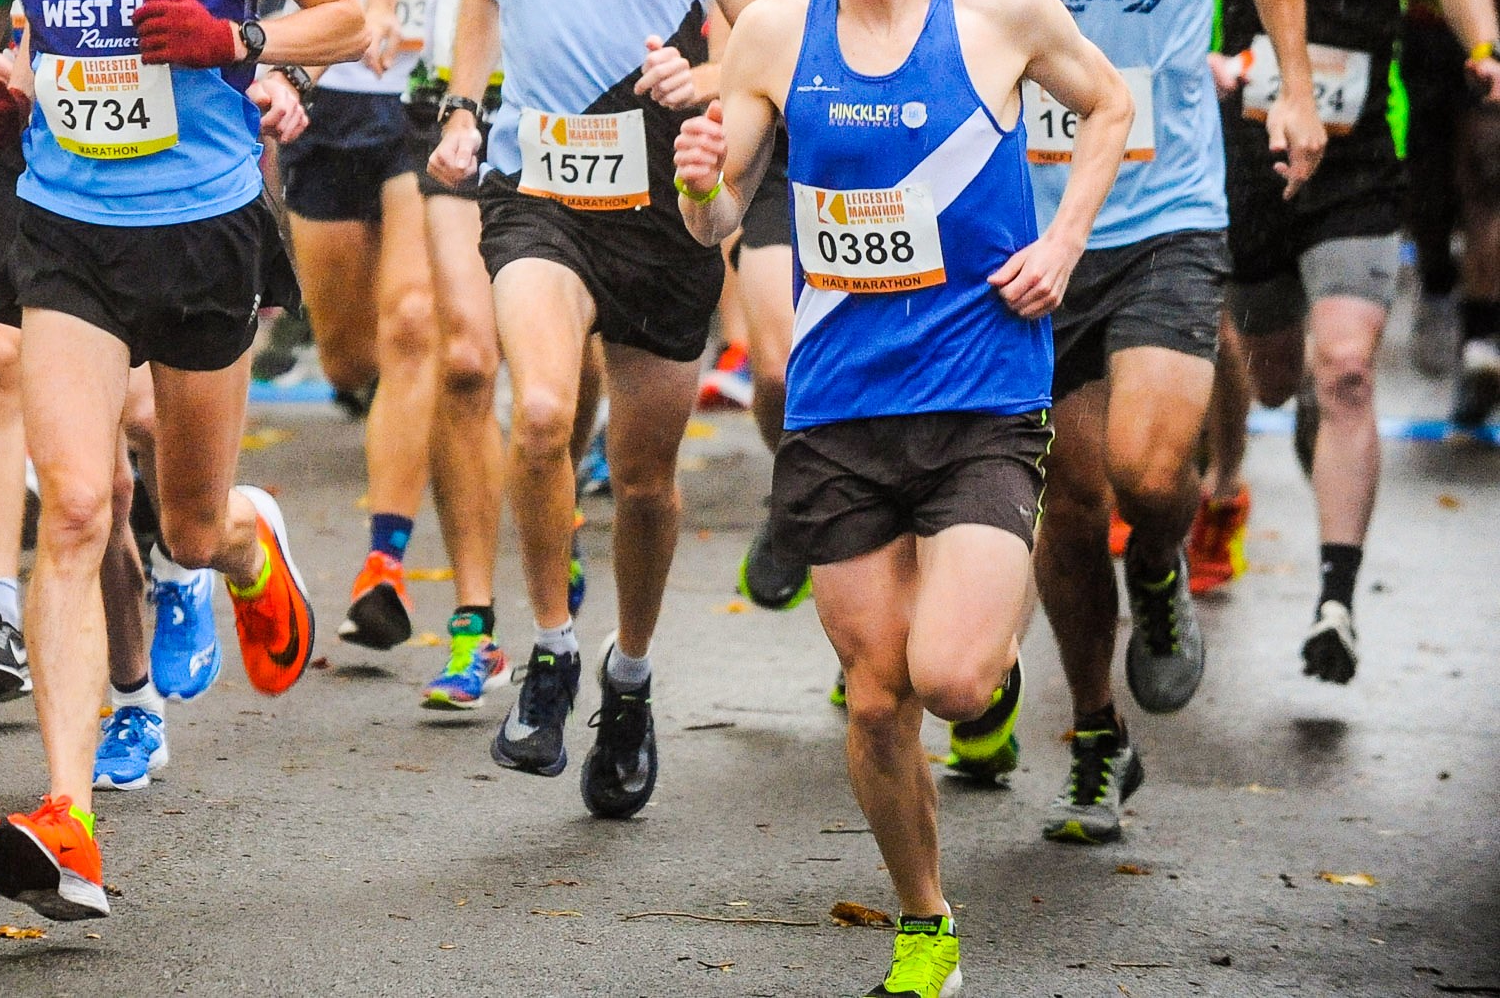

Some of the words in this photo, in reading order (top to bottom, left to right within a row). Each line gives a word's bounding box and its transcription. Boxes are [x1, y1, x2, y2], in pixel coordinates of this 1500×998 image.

[84, 58, 138, 72] LEICESTER
[86, 72, 140, 85] MARATHON
[57, 97, 151, 131] 3734
[829, 102, 893, 121] HINCKLEY
[567, 117, 618, 129] LEICESTER
[828, 118, 891, 128] RUNNING
[568, 129, 619, 141] MARATHON
[78, 145, 139, 156] MARATHON
[540, 152, 625, 184] 1577
[567, 197, 629, 208] MARATHON
[846, 190, 902, 205] LEICESTER
[848, 203, 905, 218] MARATHON
[818, 230, 915, 265] 0388
[822, 276, 849, 288] HALF
[853, 275, 921, 290] MARATHON
